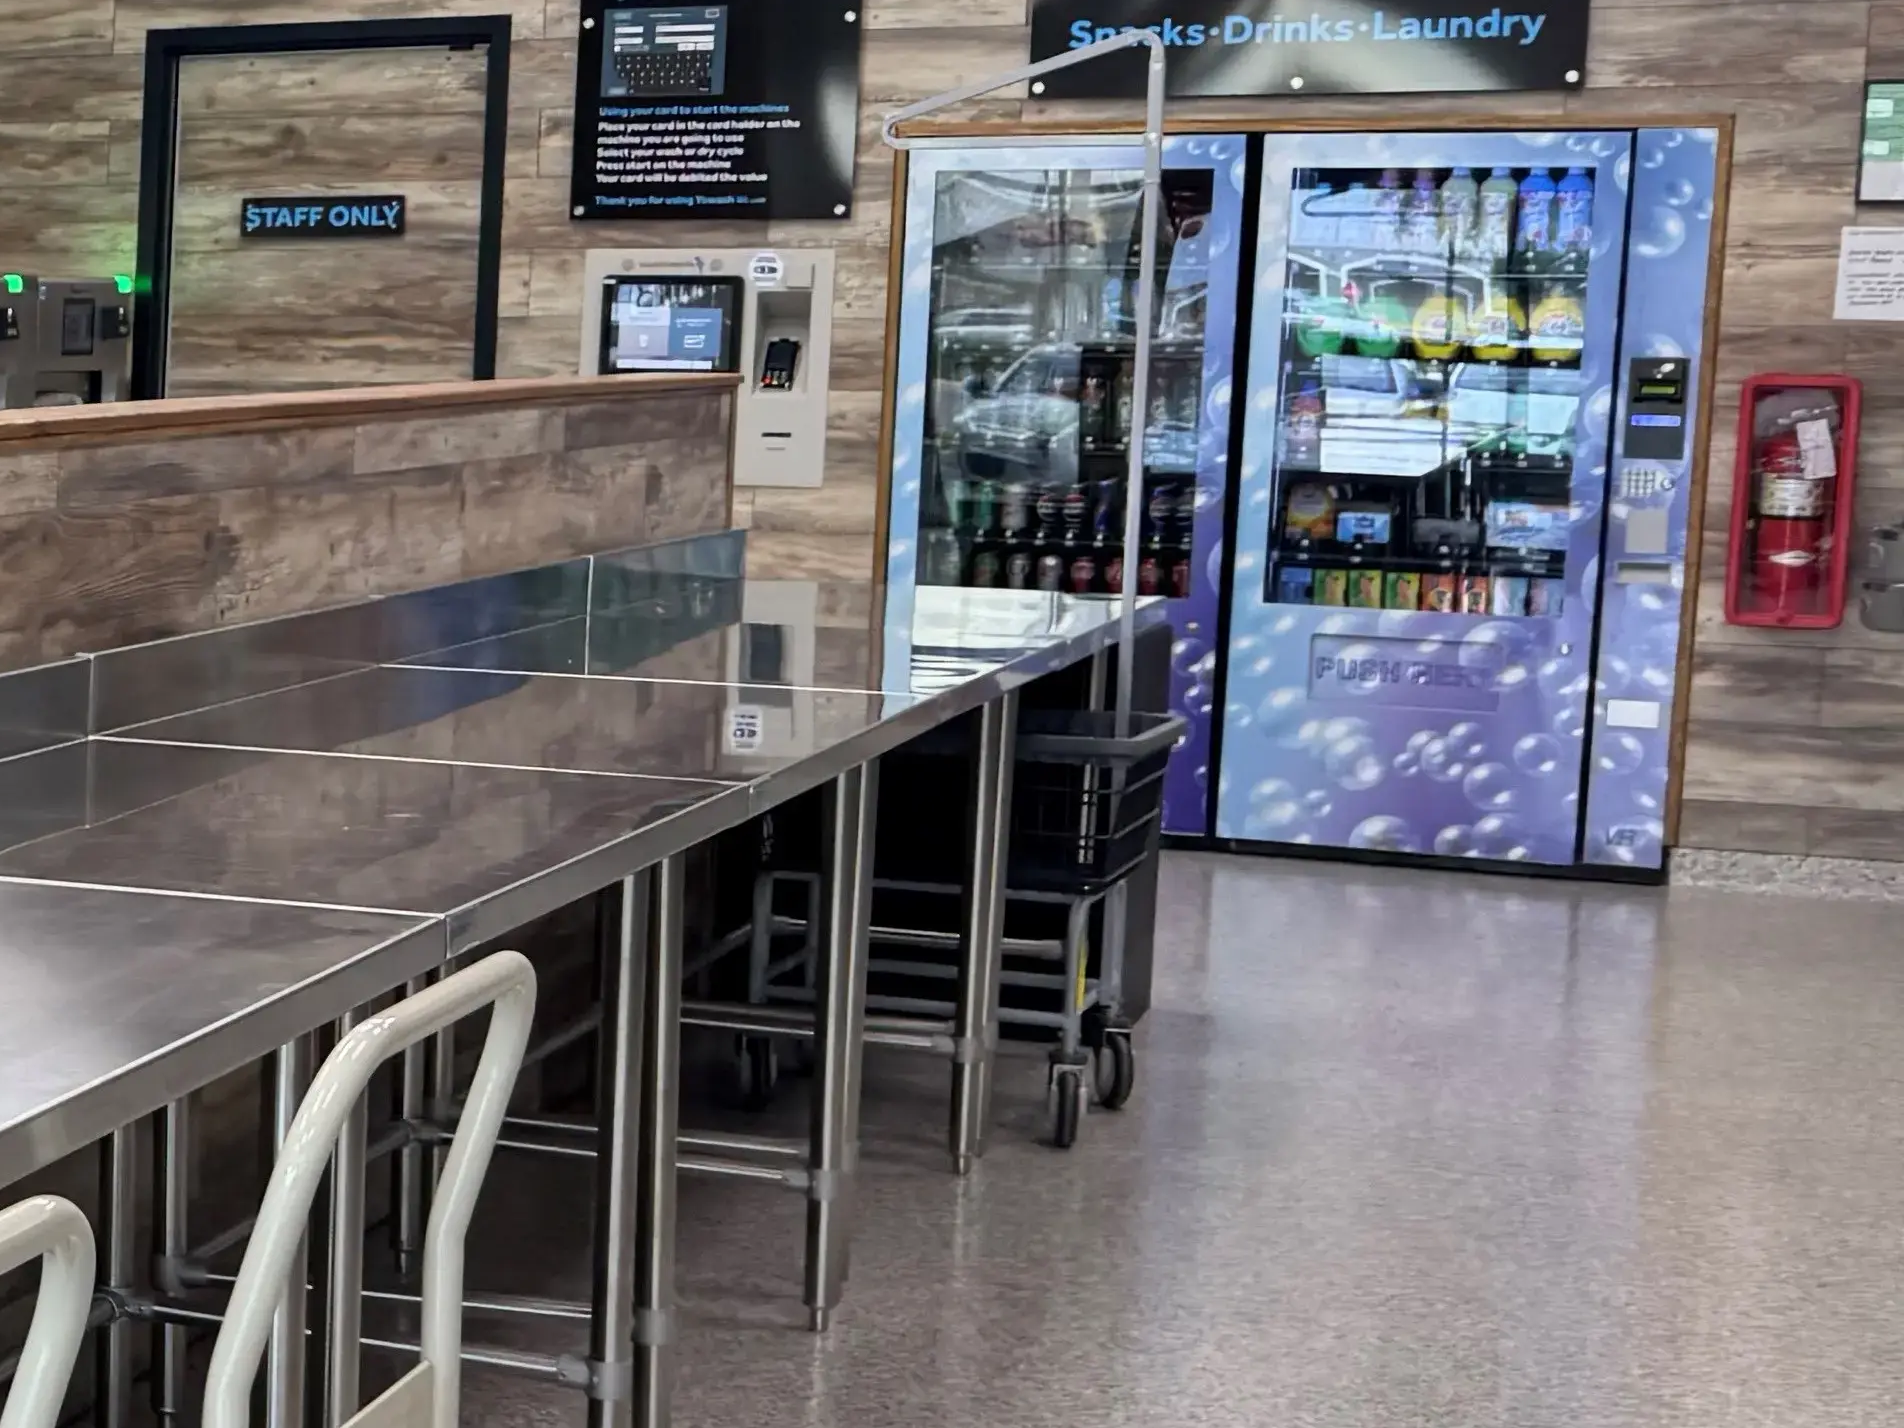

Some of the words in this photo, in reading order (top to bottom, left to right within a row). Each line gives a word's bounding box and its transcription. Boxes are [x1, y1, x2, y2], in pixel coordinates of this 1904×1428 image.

[246, 206, 324, 229] STAFF
[329, 205, 400, 227] ONLY
[1315, 656, 1401, 683] PUSH
